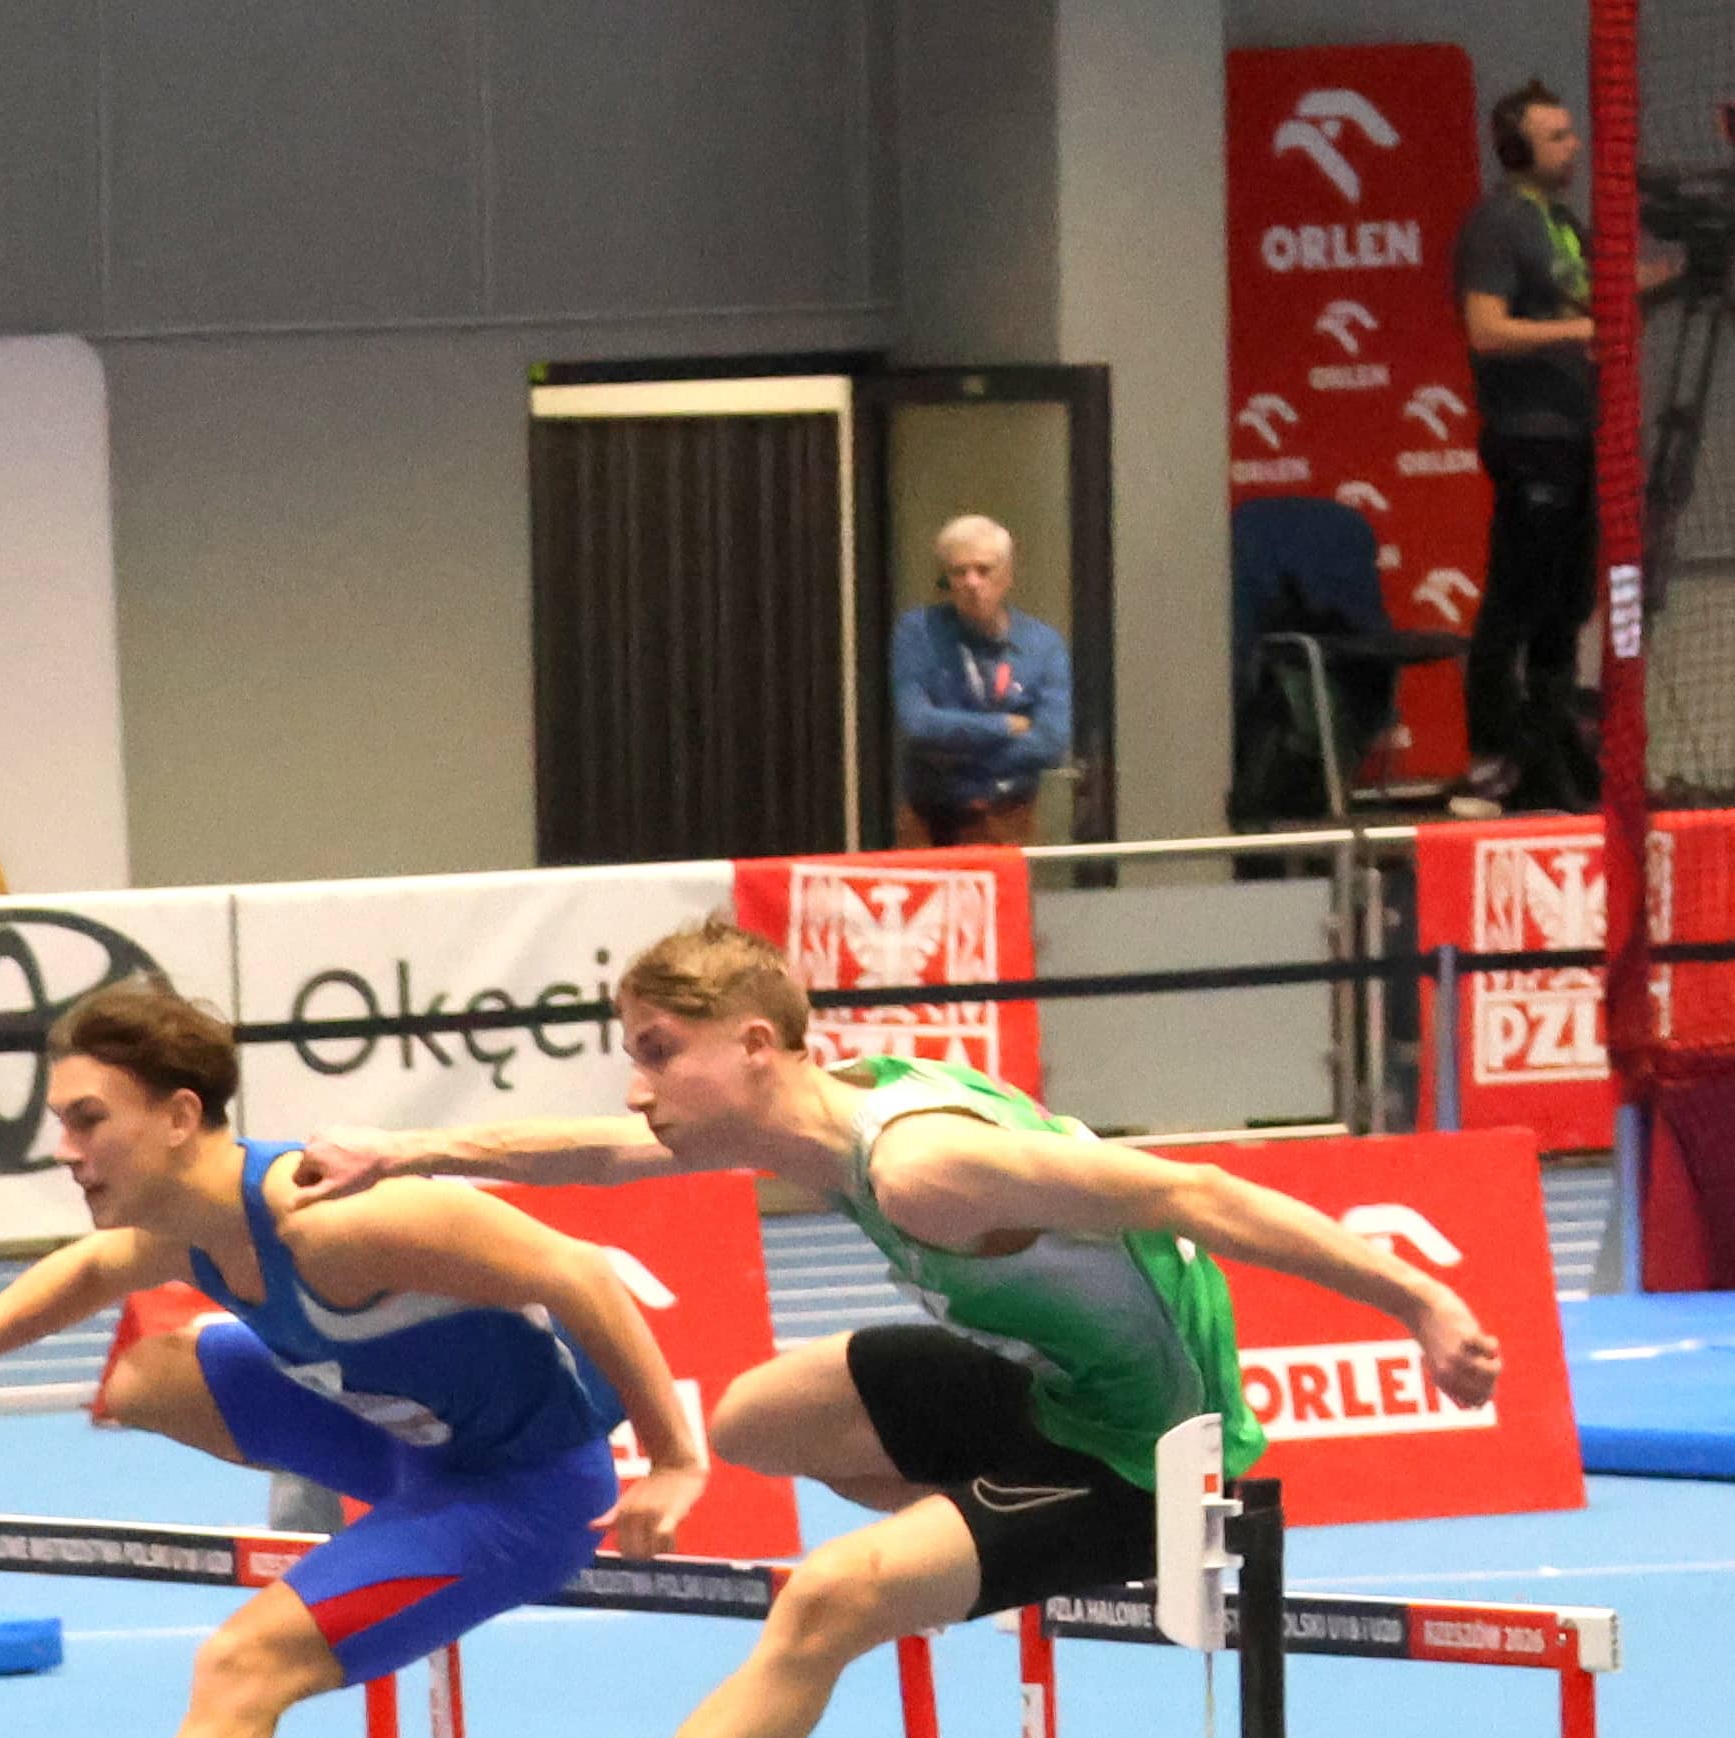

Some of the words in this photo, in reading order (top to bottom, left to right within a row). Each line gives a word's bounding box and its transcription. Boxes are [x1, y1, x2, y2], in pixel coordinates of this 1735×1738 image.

[1261, 221, 1422, 272] ORLEN
[293, 950, 619, 1090] Okęci
[1488, 1001, 1609, 1074] PZL
